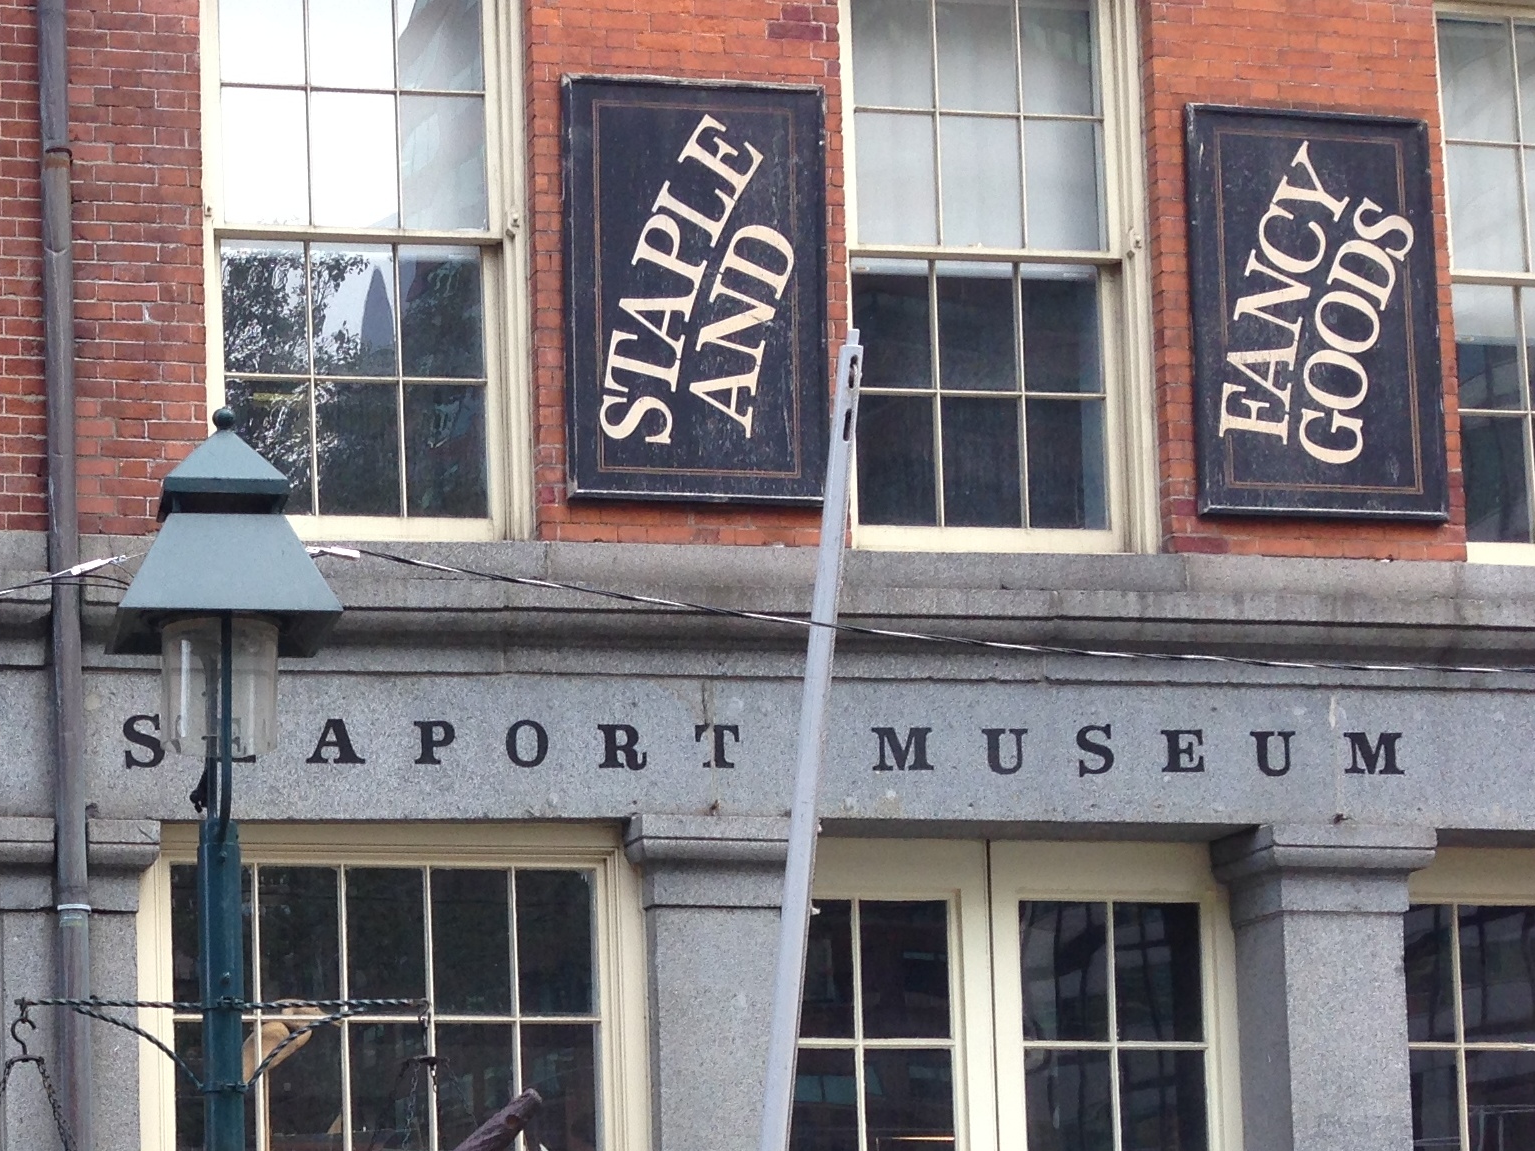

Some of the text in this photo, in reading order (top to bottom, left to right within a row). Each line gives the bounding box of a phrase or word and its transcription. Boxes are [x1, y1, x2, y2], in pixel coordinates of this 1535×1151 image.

[599, 113, 764, 444] STAPLE
[688, 224, 795, 439] AND
[1218, 140, 1350, 446] FANCY
[1299, 197, 1415, 464] GOODS
[871, 723, 1405, 777] MUSEUM
